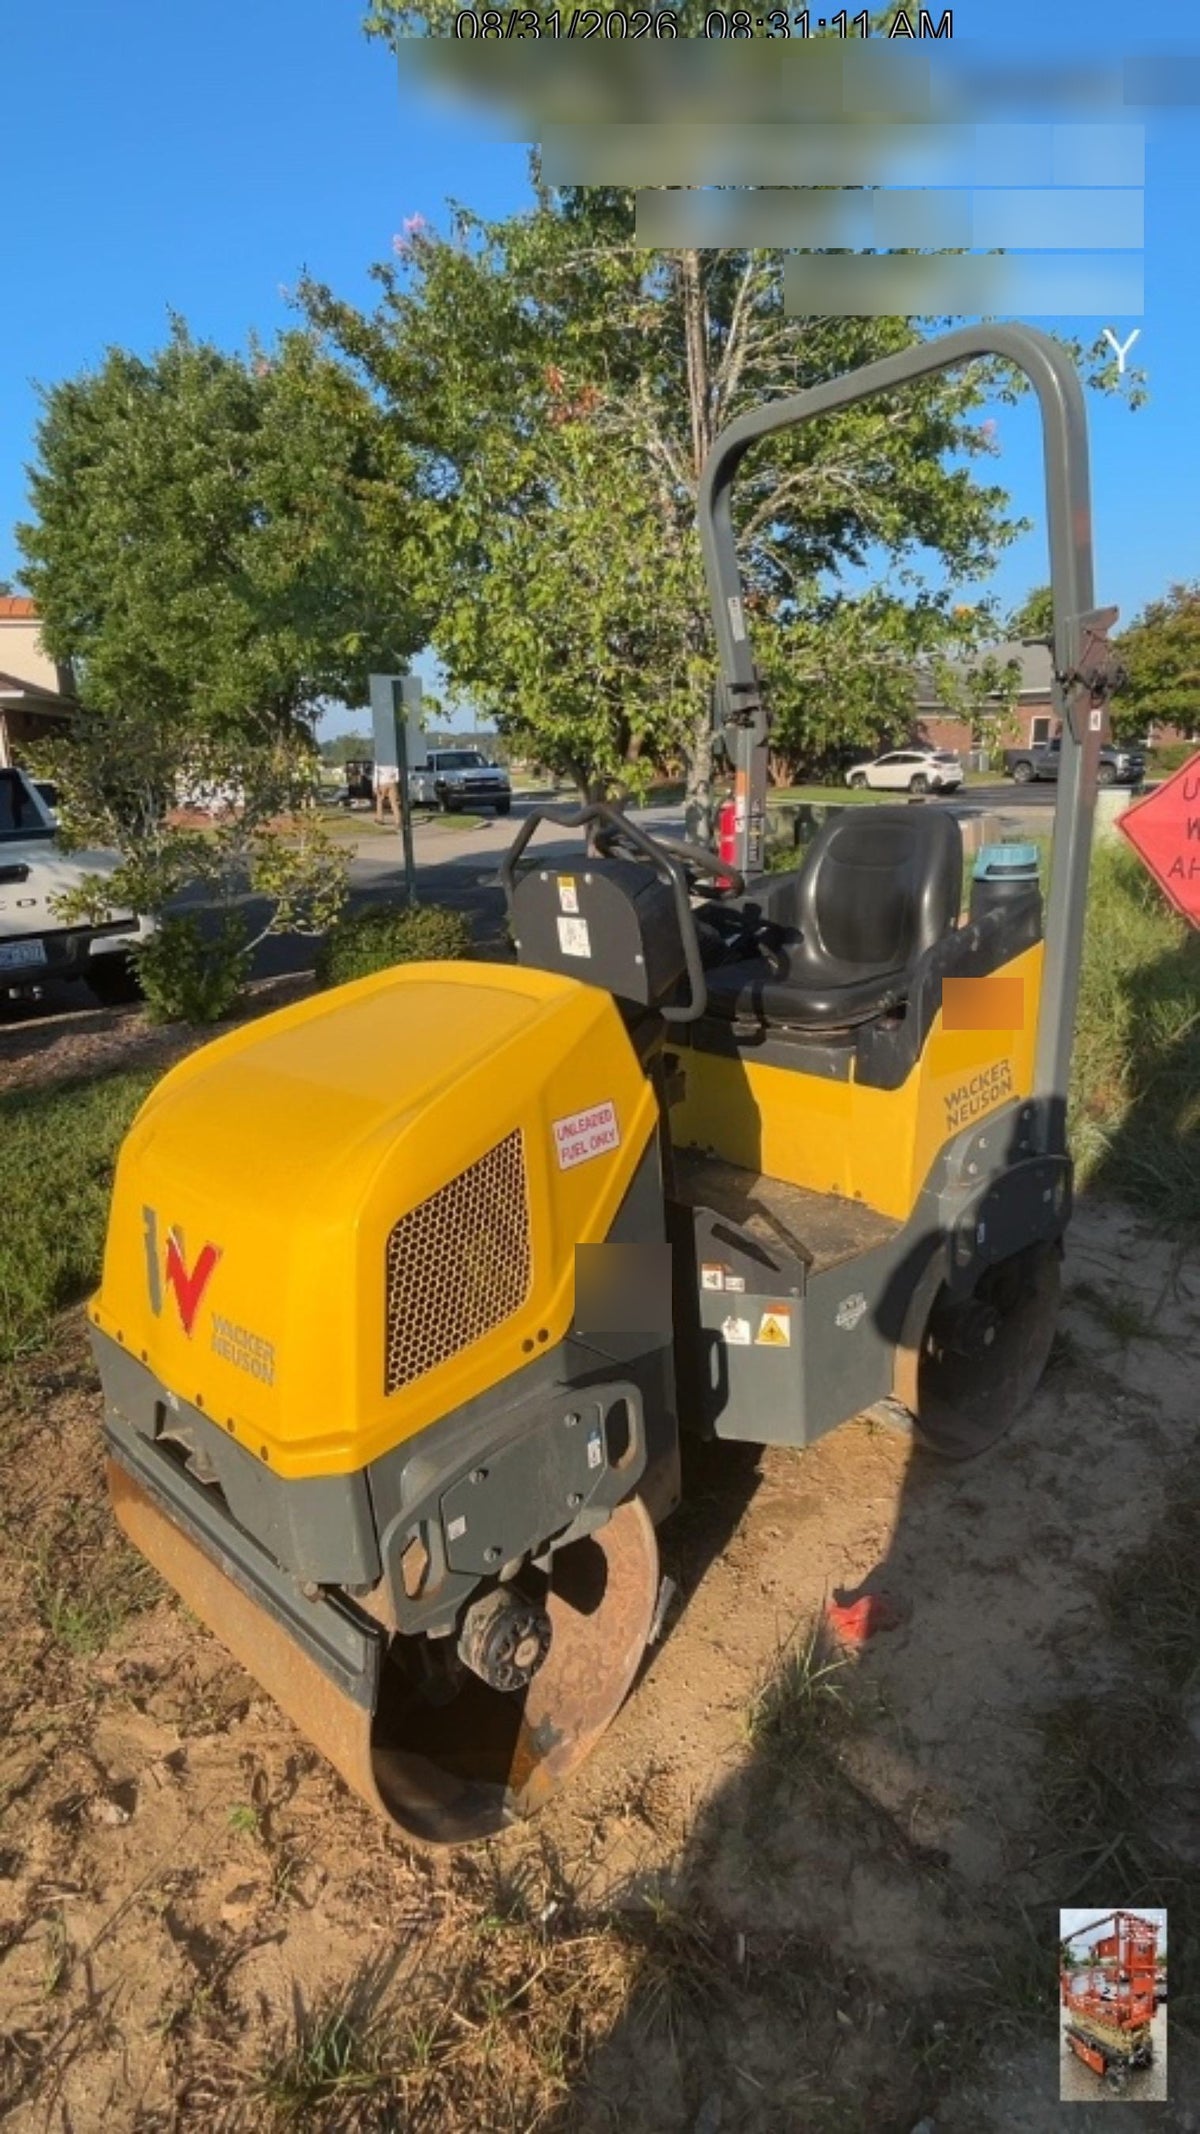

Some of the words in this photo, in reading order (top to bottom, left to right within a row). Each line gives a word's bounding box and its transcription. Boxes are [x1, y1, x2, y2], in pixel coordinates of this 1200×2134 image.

[1182, 777, 1200, 802] U
[944, 1058, 1010, 1110] WACKER
[946, 1076, 1012, 1133] NEUSON
[557, 1109, 612, 1142] UNLEADED
[561, 1141, 588, 1162] FUEL
[590, 1128, 615, 1150] ONLY
[211, 1311, 275, 1366] WACKER
[211, 1332, 275, 1388] NEUSON
